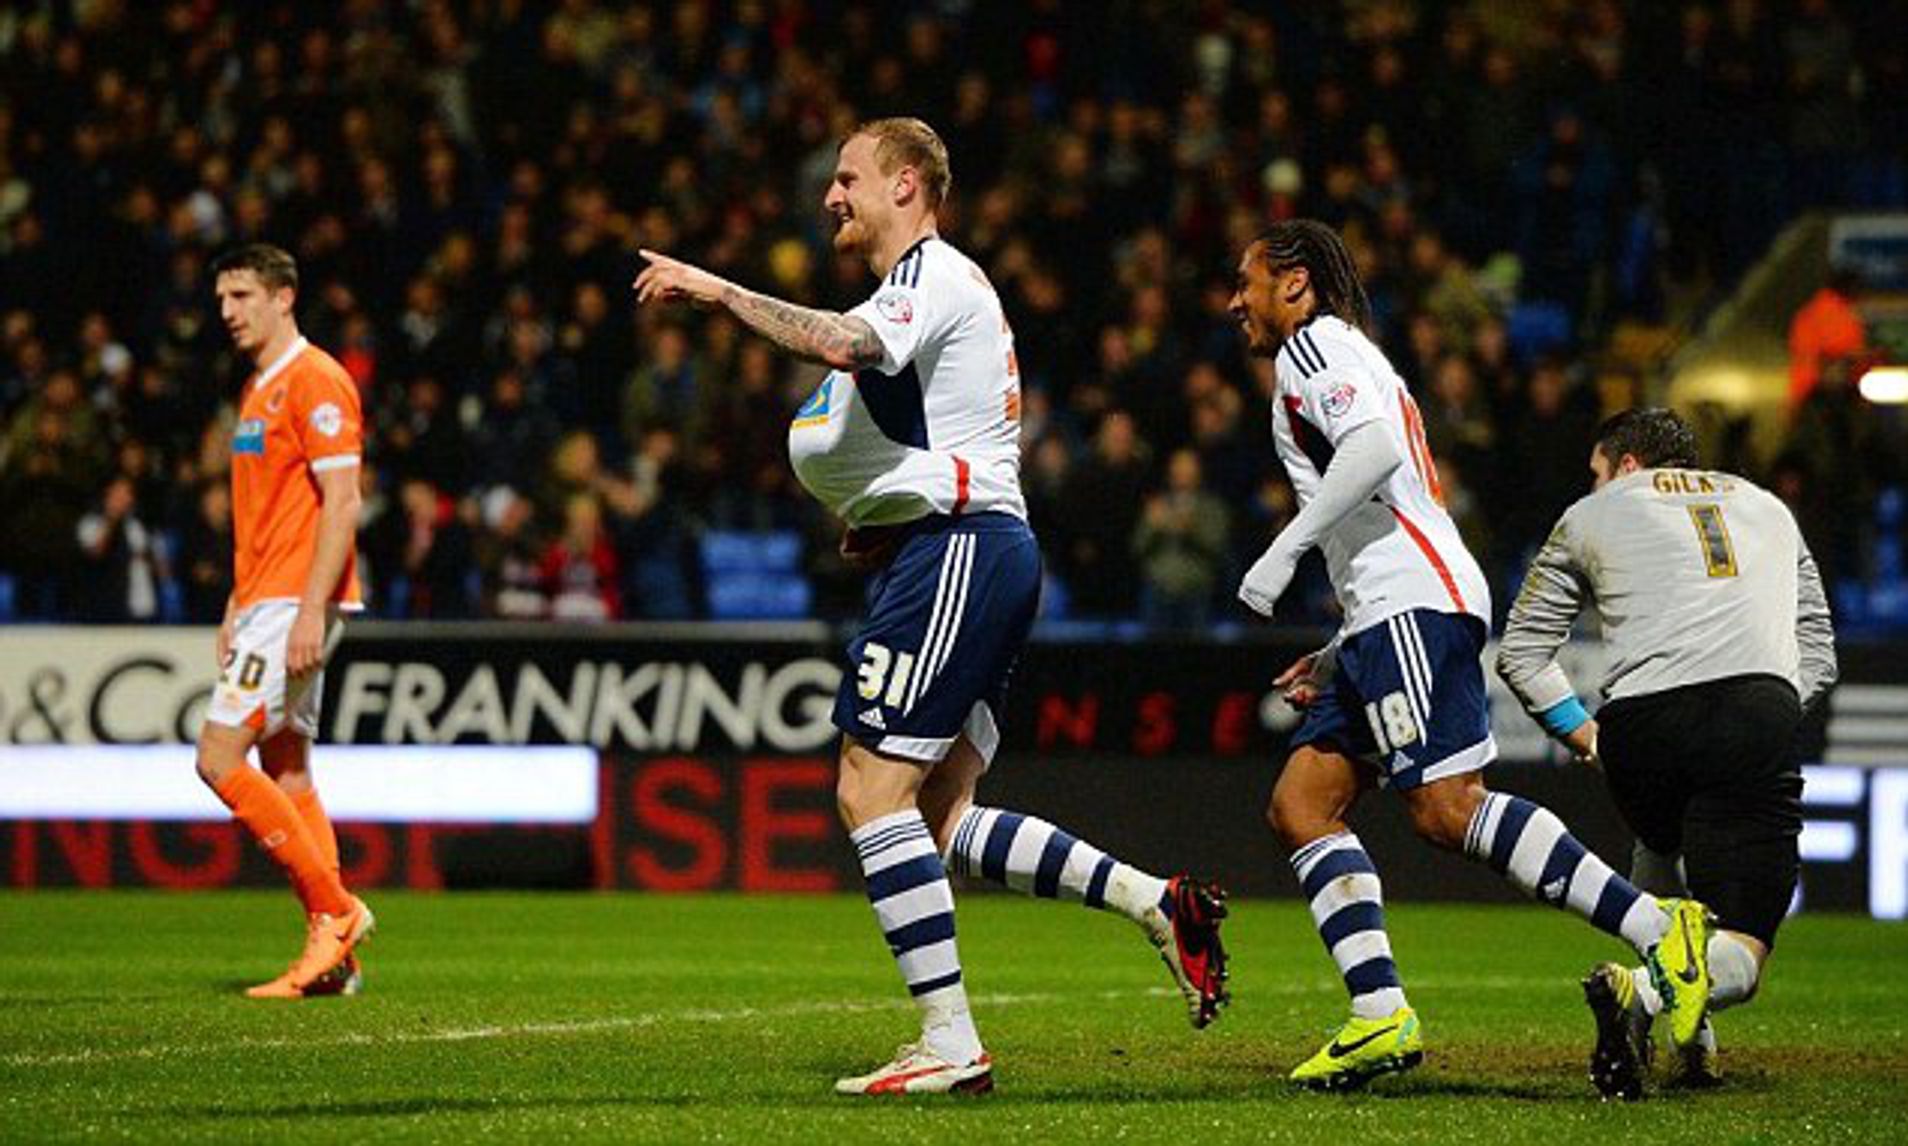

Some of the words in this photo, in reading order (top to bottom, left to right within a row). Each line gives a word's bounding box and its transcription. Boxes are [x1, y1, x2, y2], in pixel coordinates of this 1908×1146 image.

[1652, 470, 1736, 494] GILK
[1685, 503, 1738, 577] 1
[333, 659, 845, 751] FRANKING
[858, 642, 914, 708] 31
[1364, 690, 1418, 755] 18
